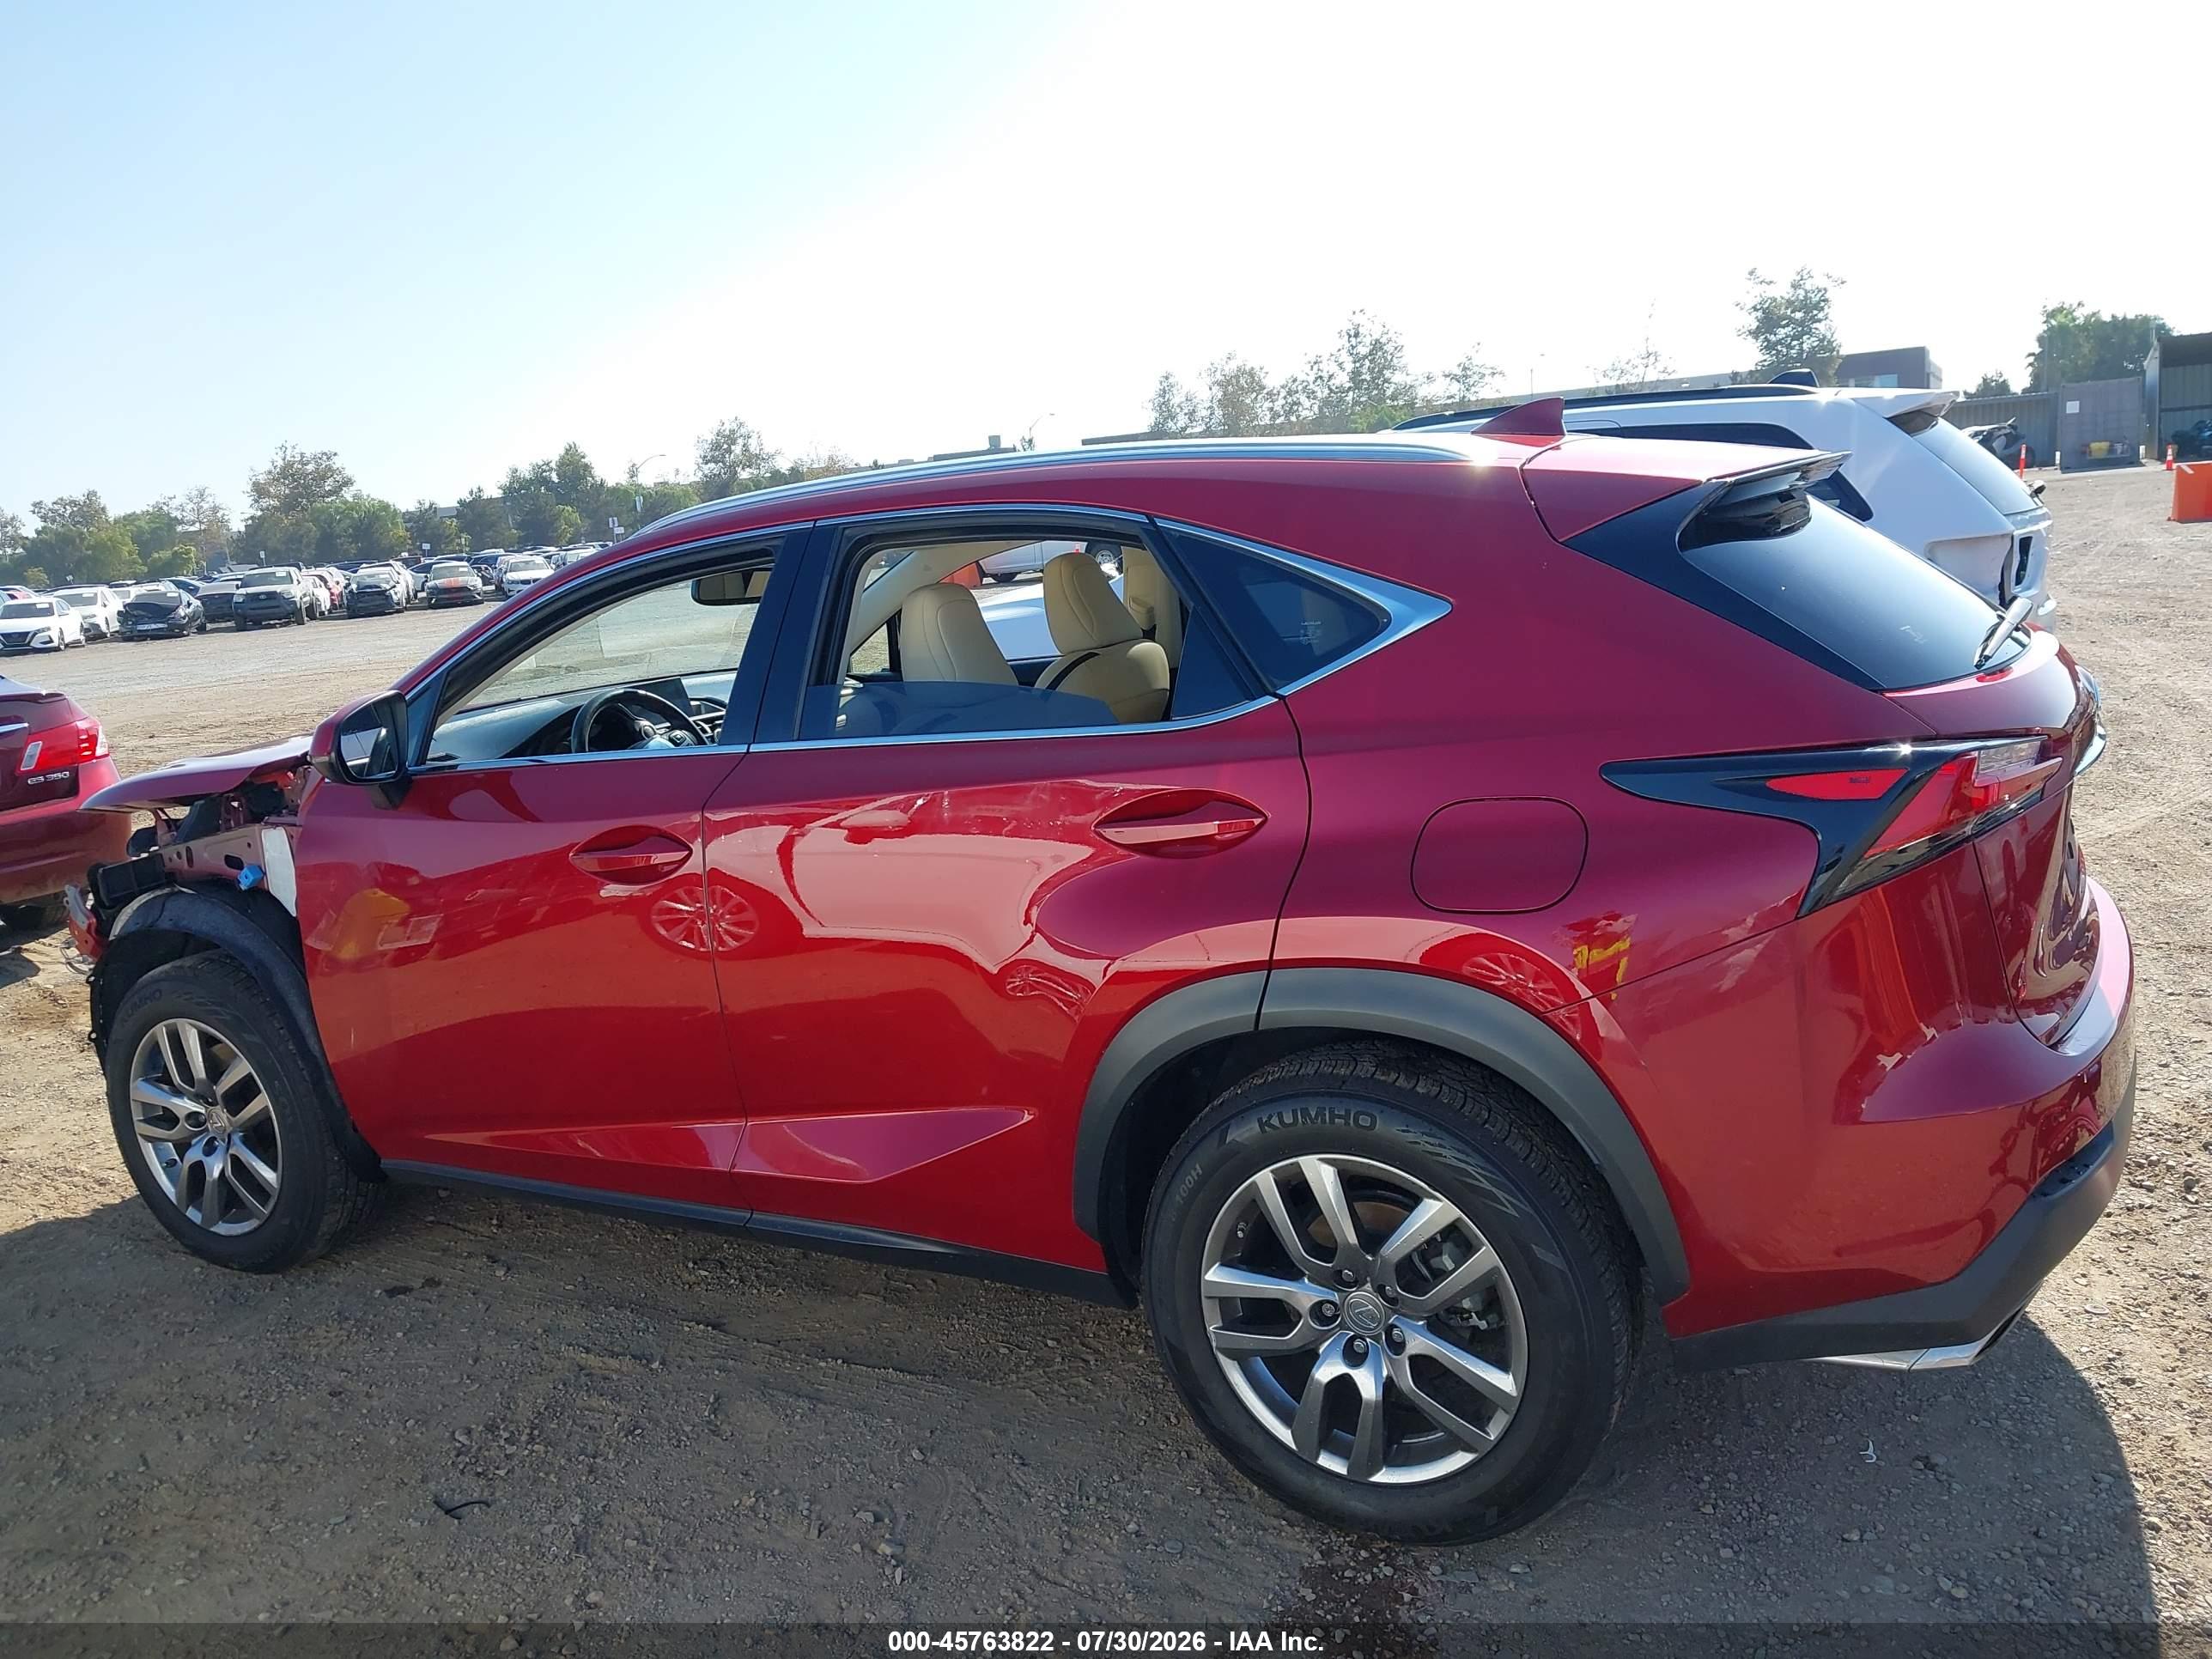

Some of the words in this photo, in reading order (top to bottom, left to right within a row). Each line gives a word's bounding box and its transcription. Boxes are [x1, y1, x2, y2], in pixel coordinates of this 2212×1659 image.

[27, 775, 45, 785] ES
[46, 771, 70, 781] 350
[1256, 1106, 1379, 1134] KUMHO
